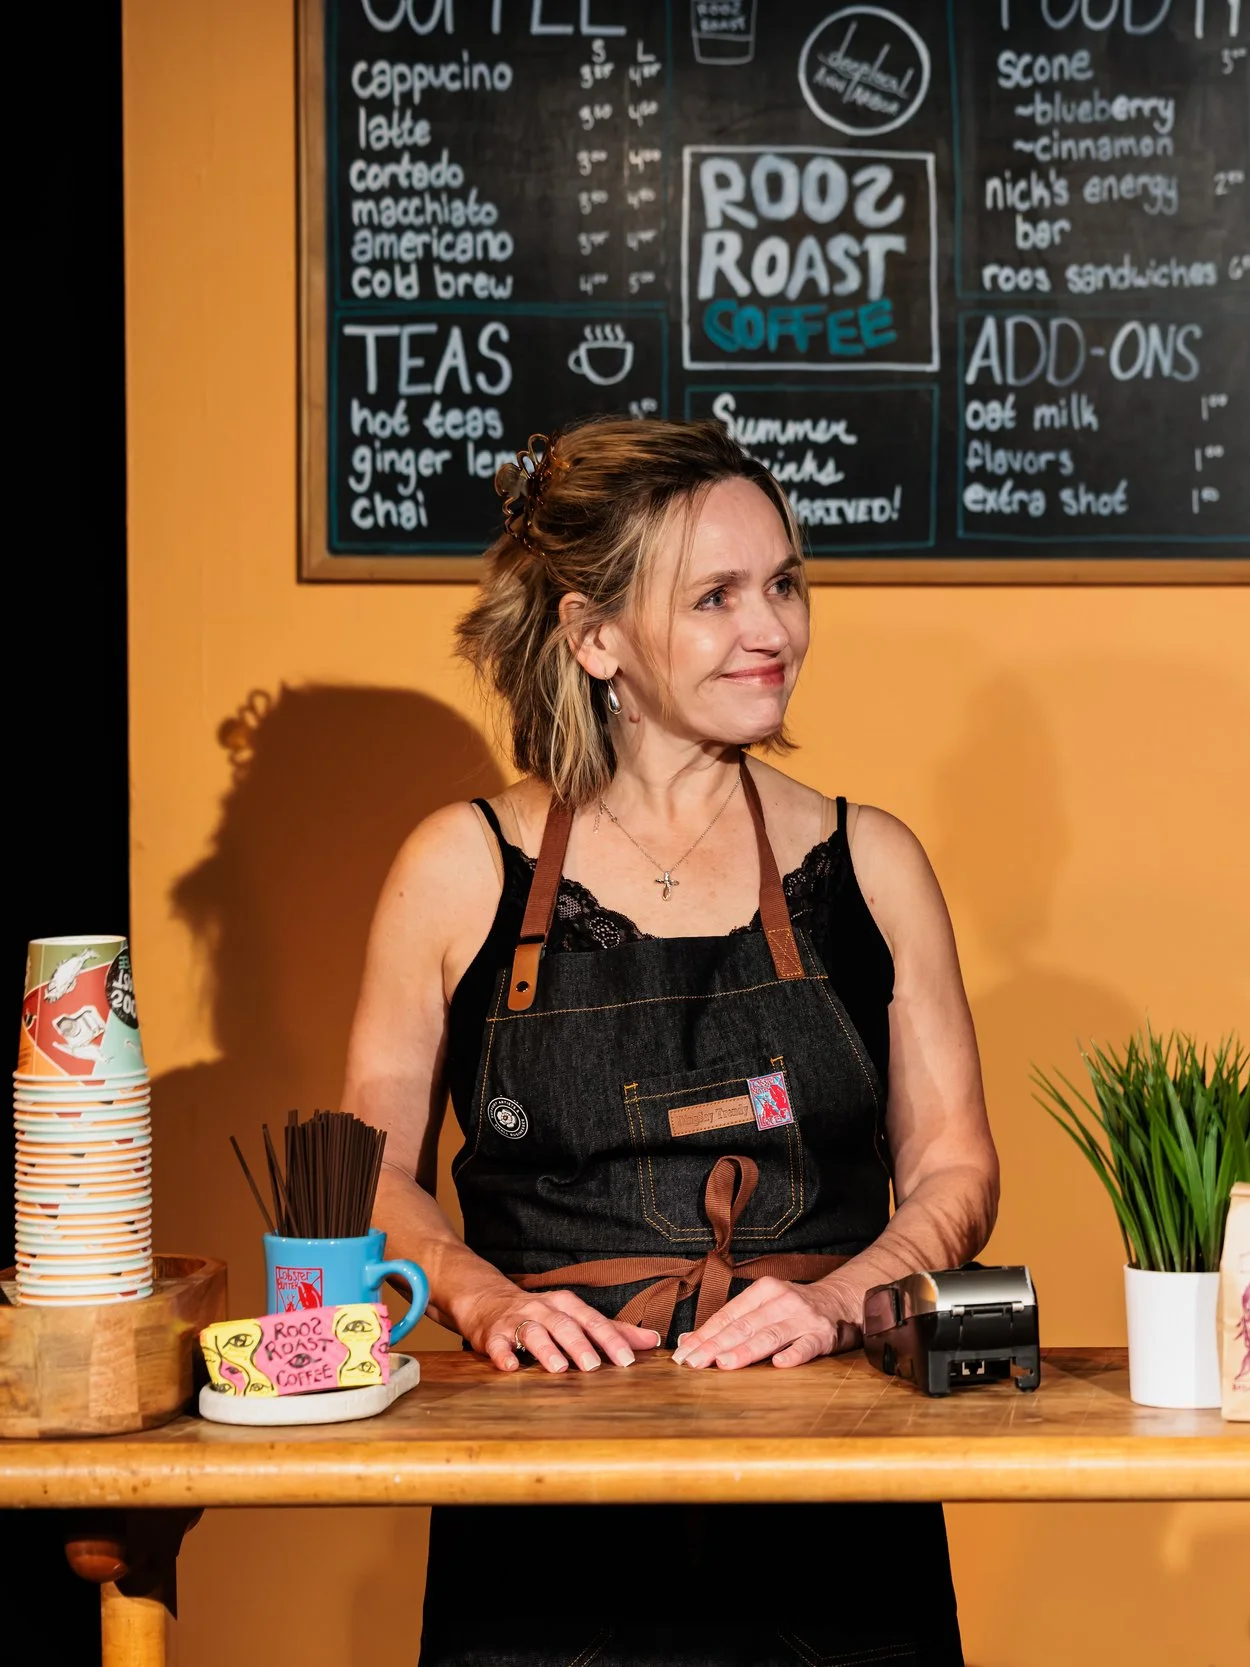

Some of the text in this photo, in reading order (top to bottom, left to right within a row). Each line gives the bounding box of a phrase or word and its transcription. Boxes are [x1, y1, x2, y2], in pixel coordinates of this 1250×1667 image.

[637, 39, 656, 63] L
[998, 50, 1093, 88] scone
[351, 49, 513, 106] cappucino
[358, 106, 431, 150] latte
[349, 148, 464, 192] cortado
[352, 187, 498, 227] macchiato
[1083, 173, 1179, 215] energy
[351, 227, 514, 263] americano
[1015, 213, 1071, 250] bar
[351, 263, 419, 299] cold
[433, 264, 513, 299] brew
[697, 229, 906, 301] ROAST
[982, 262, 1051, 293] roos
[1065, 253, 1218, 293] sandwiches
[704, 297, 897, 355] COFFEE
[343, 321, 512, 396] TEAS
[964, 314, 1203, 387] ADD-ONS
[351, 398, 410, 438] hot
[423, 401, 504, 439] teas
[713, 393, 857, 445] Summer
[965, 393, 1017, 431] oat
[1033, 390, 1099, 431] milk
[348, 440, 452, 497] ginger
[965, 439, 1074, 477] flavors
[351, 492, 428, 530] chai
[963, 479, 1047, 518] extra
[1059, 479, 1128, 517] shot
[264, 1337, 334, 1361] ROAST
[276, 1364, 333, 1387] COFFEE
